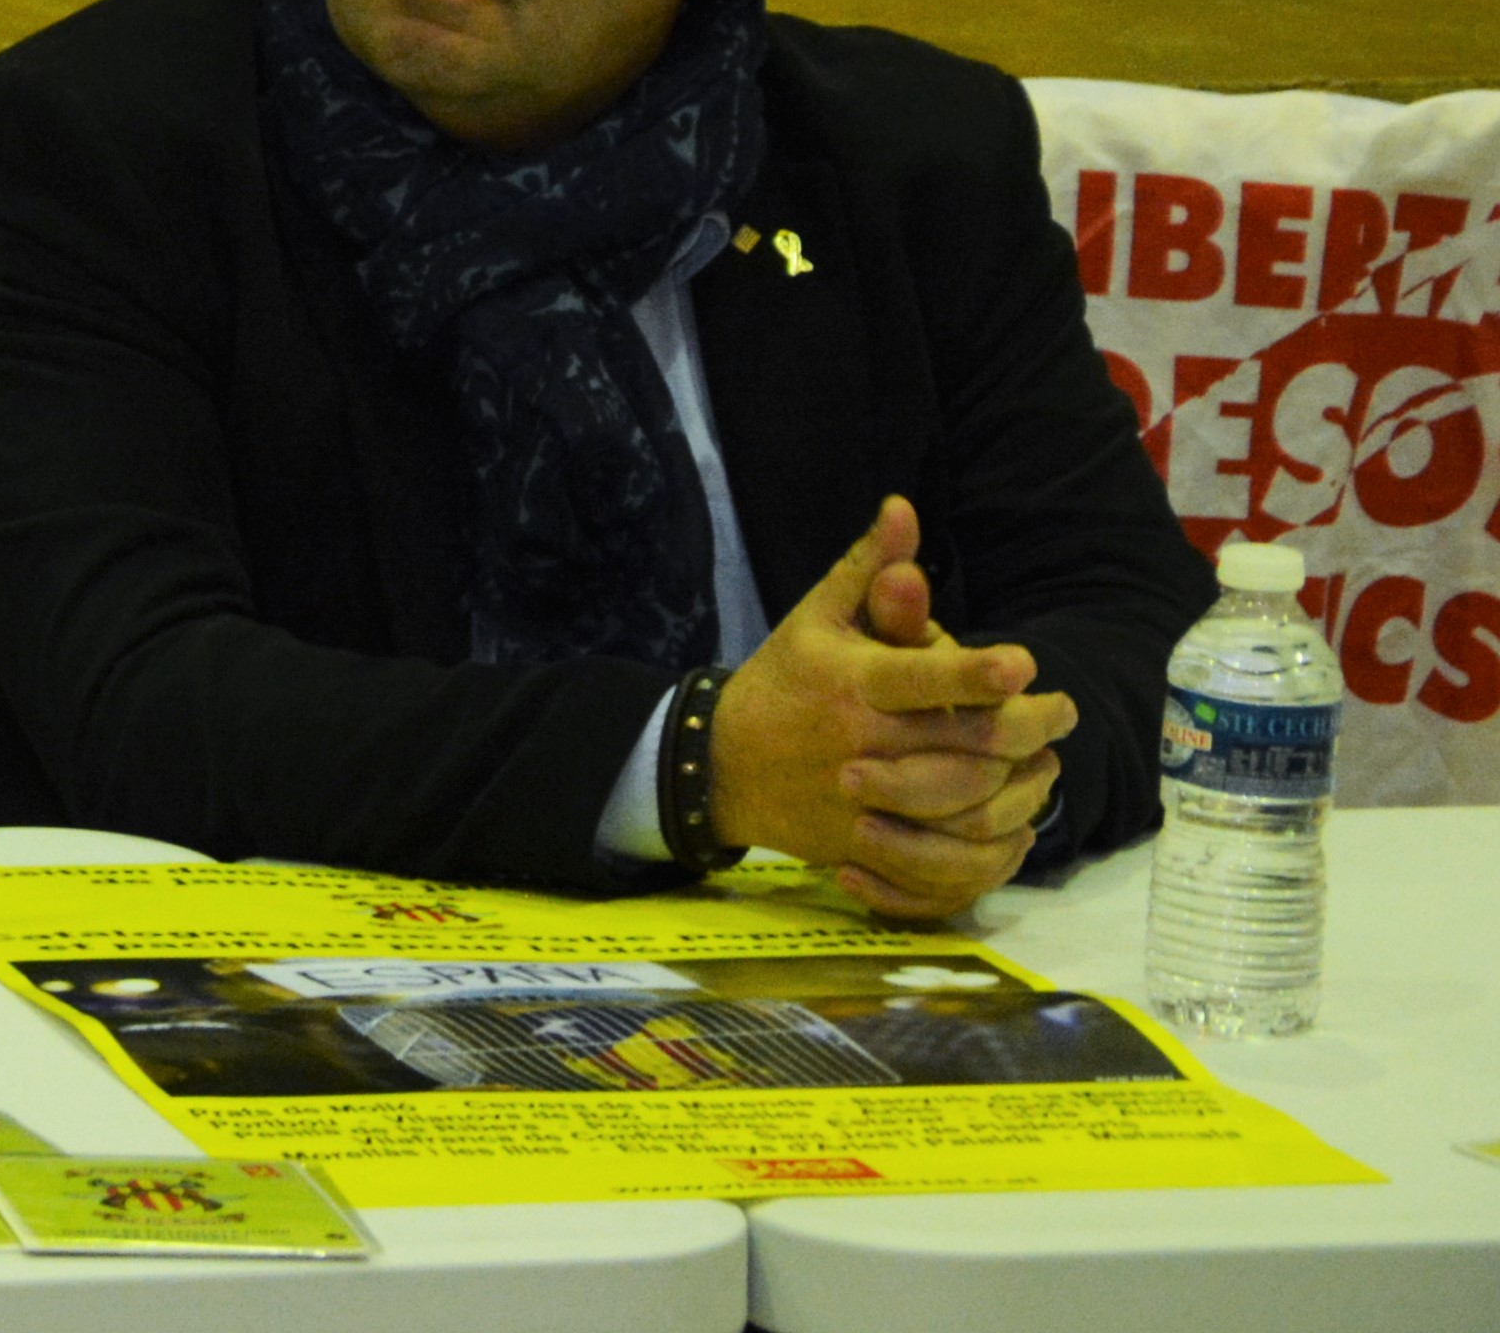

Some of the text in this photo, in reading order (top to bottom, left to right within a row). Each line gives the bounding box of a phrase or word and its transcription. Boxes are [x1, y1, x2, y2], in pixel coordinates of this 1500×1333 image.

[1074, 169, 1500, 325] IBERT
[168, 866, 278, 876] dans
[114, 941, 368, 951] pacifique
[391, 943, 505, 951] pour
[597, 938, 912, 954] démocratie
[302, 962, 645, 992] ESPAÑA
